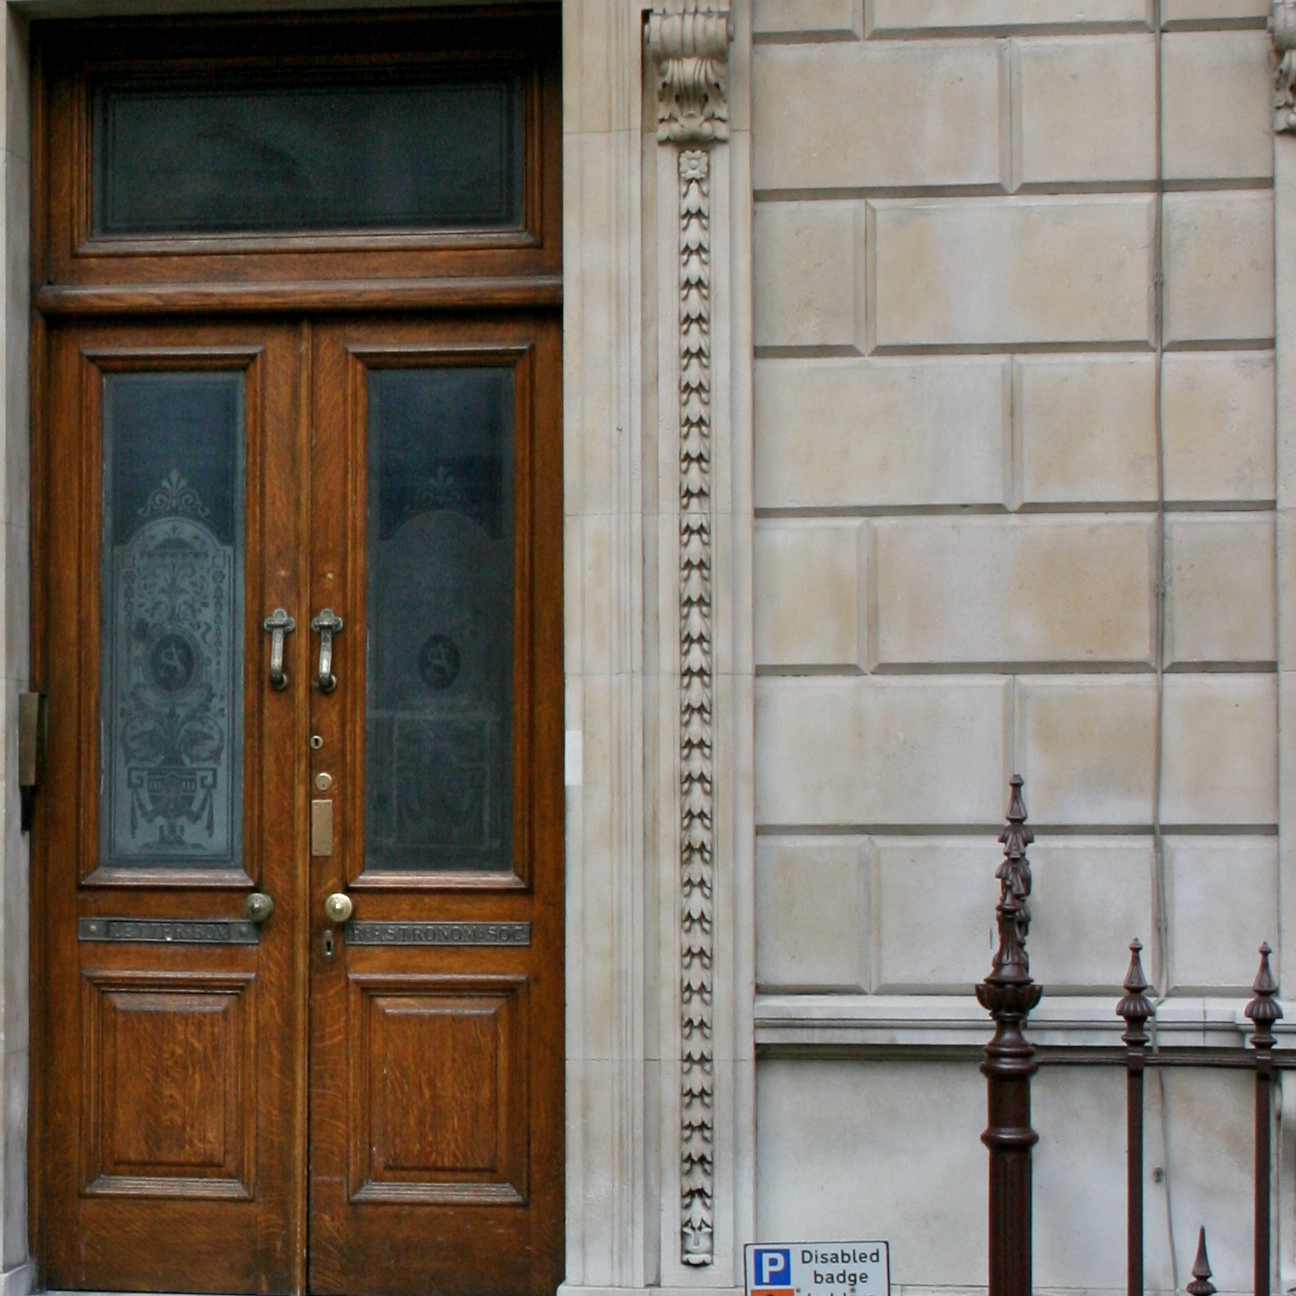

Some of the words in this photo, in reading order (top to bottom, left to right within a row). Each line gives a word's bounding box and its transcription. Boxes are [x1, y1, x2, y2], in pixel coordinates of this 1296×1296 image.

[801, 1249, 880, 1264] Disabled
[761, 1252, 785, 1283] P
[813, 1269, 868, 1286] badge
